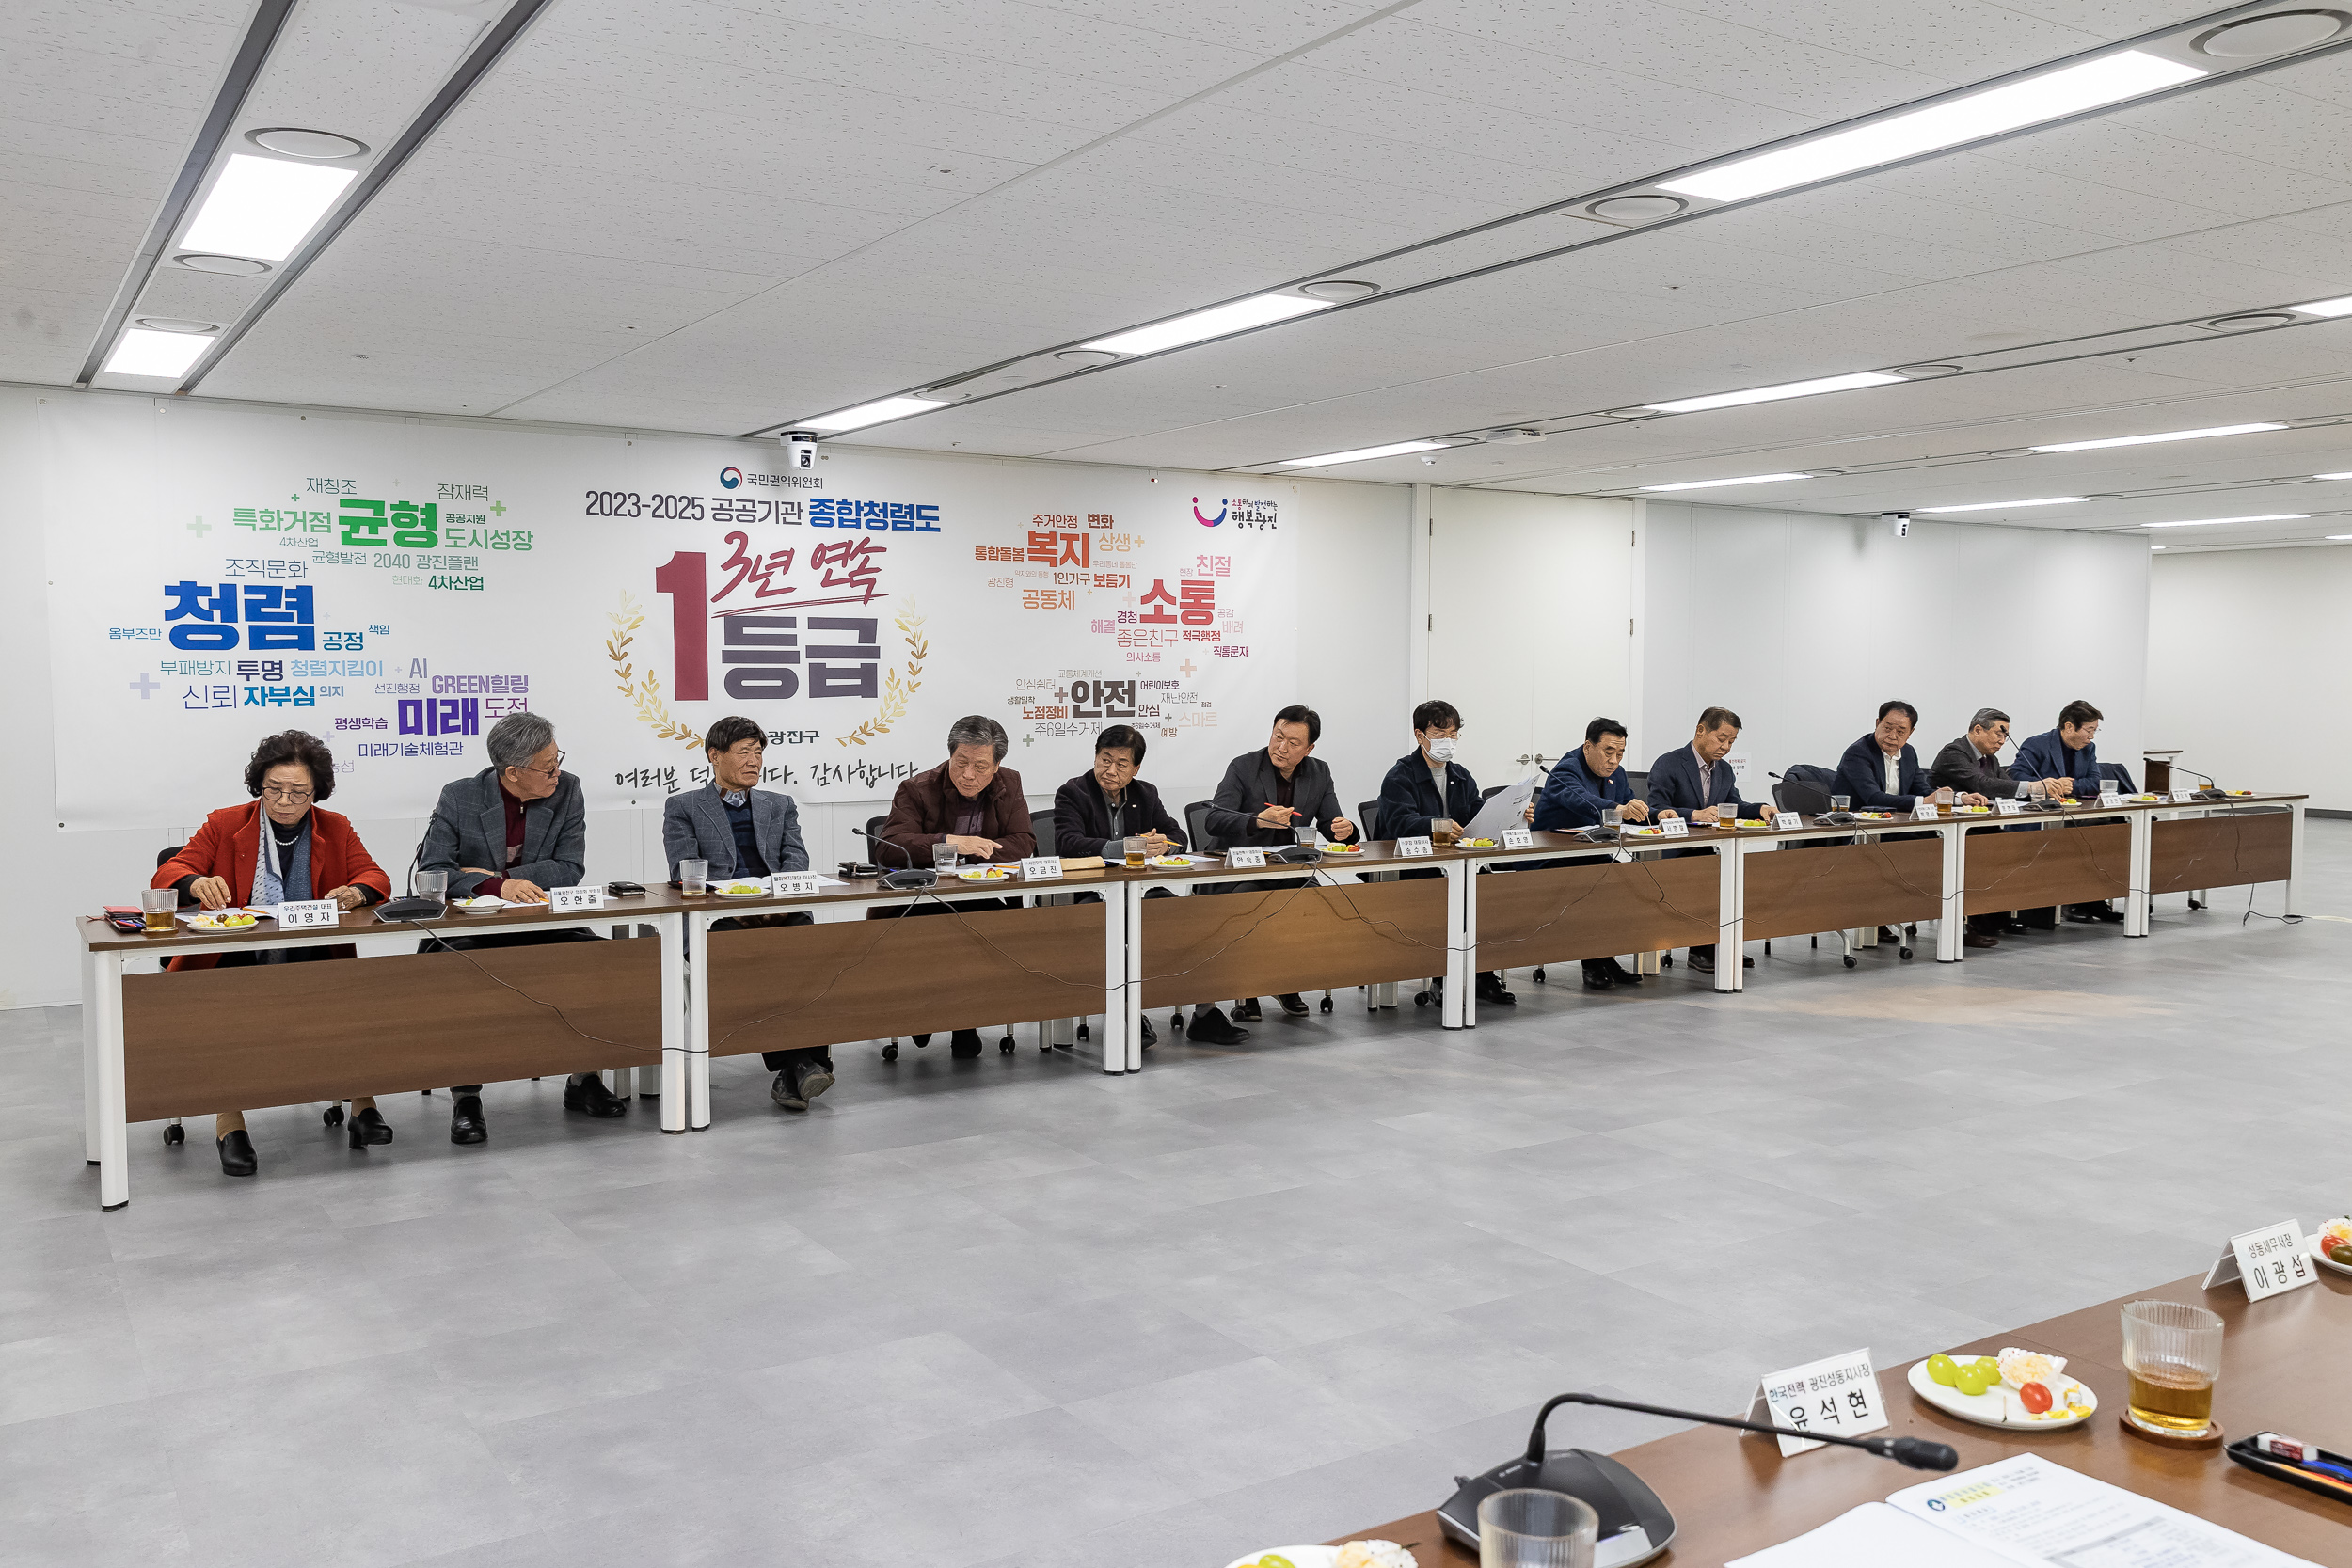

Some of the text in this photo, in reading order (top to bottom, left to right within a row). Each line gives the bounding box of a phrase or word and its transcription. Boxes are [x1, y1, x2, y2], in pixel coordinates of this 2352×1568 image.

[306, 477, 358, 495] 재창조
[746, 473, 823, 490] 국민권익위원회
[437, 483, 489, 501] 잠재력
[585, 490, 942, 533] 2023-2025 공공기관 종합청렴도
[1254, 500, 1279, 512] 발전하는
[232, 507, 332, 533] 특화거점
[338, 498, 439, 549] 균형
[445, 513, 486, 525] 공공지원
[1032, 514, 1078, 529] 주거안정
[1087, 513, 1115, 530] 변화
[1231, 509, 1278, 531] 행복광진
[279, 536, 319, 548] 4차산업
[444, 528, 534, 552] 도시성장
[1098, 532, 1132, 553] 상생
[311, 550, 367, 566] 균형발전
[975, 546, 1025, 562] 통합돌봄
[1026, 530, 1090, 569] 복지
[224, 558, 309, 579] 조직문화
[373, 552, 480, 572] 2040 광진플랜
[710, 531, 888, 606] 3년 연속
[1196, 554, 1232, 578] 친절
[392, 574, 423, 586] 현대화
[1053, 572, 1131, 589] 1인가구 보듬기
[1179, 567, 1194, 578] 현장
[428, 575, 484, 592] 4차산업
[987, 577, 1014, 589] 광진형
[1022, 588, 1075, 610] 공동체
[1140, 578, 1216, 626] 소통
[163, 580, 316, 651] 청렴
[1117, 610, 1138, 625] 경청
[1217, 608, 1234, 619] 공감
[108, 627, 163, 641] 옴부즈만
[368, 624, 391, 636] 책임
[1090, 619, 1116, 635] 해결
[1182, 629, 1221, 642] 적극행정
[1222, 620, 1244, 635] 배려
[322, 631, 365, 651] 공정
[1116, 628, 1179, 649] 좋은친구
[1126, 651, 1162, 663] 의사소통
[1213, 645, 1249, 658] 직통문자
[159, 659, 231, 677] 부패방지
[236, 659, 284, 682] 투명
[289, 659, 384, 678] 청렴지킴이
[408, 657, 428, 679] AI
[1057, 669, 1103, 679] 교통체계개선
[319, 685, 344, 698] 의지
[373, 682, 421, 695] 선진행정
[431, 674, 529, 694] GREEN힐링
[1015, 678, 1056, 691] 안심쉼터
[1139, 680, 1181, 690] 어린이보호
[182, 684, 238, 710] 신뢰
[243, 685, 316, 707] 자부심
[1007, 695, 1036, 705] 생활밀착
[1070, 679, 1136, 719] 안전
[1160, 691, 1199, 705] 재난안전
[397, 697, 480, 736] 미래
[1022, 705, 1069, 720] 노점정비
[1137, 704, 1161, 718] 안심
[1178, 711, 1218, 728] 스마트
[334, 716, 389, 731] 평생학습
[1034, 721, 1104, 737] 주6일수거제
[767, 730, 821, 745] 광진구
[1160, 727, 1179, 738] 예방
[358, 741, 464, 757] 미래기술체험관
[614, 765, 682, 795] 여러분
[2248, 1232, 2294, 1259] 성동세무서장
[1769, 1362, 1871, 1403] 한국전력 광진성동지사장
